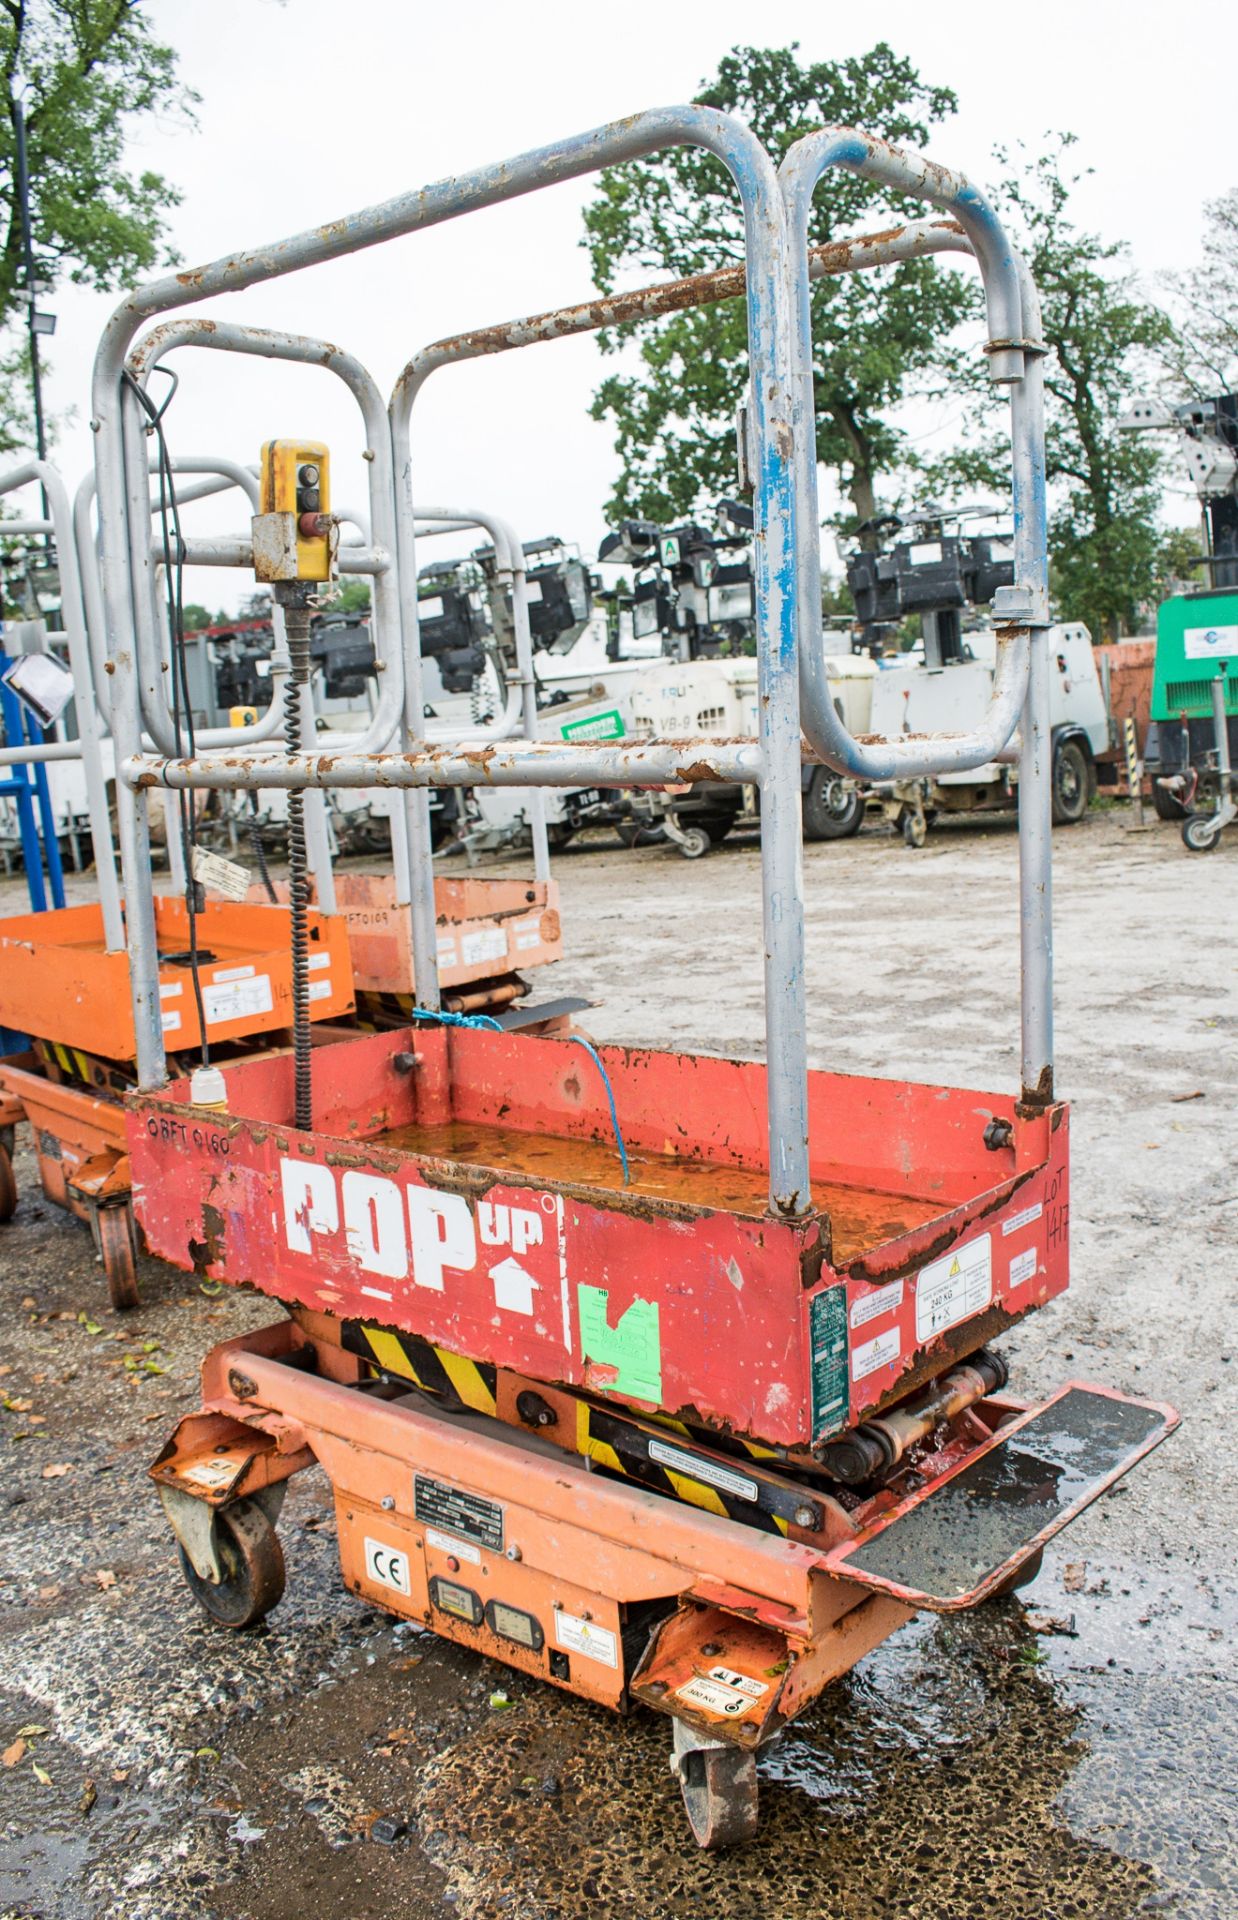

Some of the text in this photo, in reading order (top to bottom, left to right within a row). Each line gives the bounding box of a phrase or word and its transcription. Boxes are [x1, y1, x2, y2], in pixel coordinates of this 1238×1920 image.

[1043, 1165, 1066, 1206] LOT
[279, 1157, 478, 1291] POP
[476, 1200, 543, 1255] UP
[931, 1296, 943, 1309] 240
[943, 1290, 953, 1302] KG
[373, 1550, 402, 1586] CE
